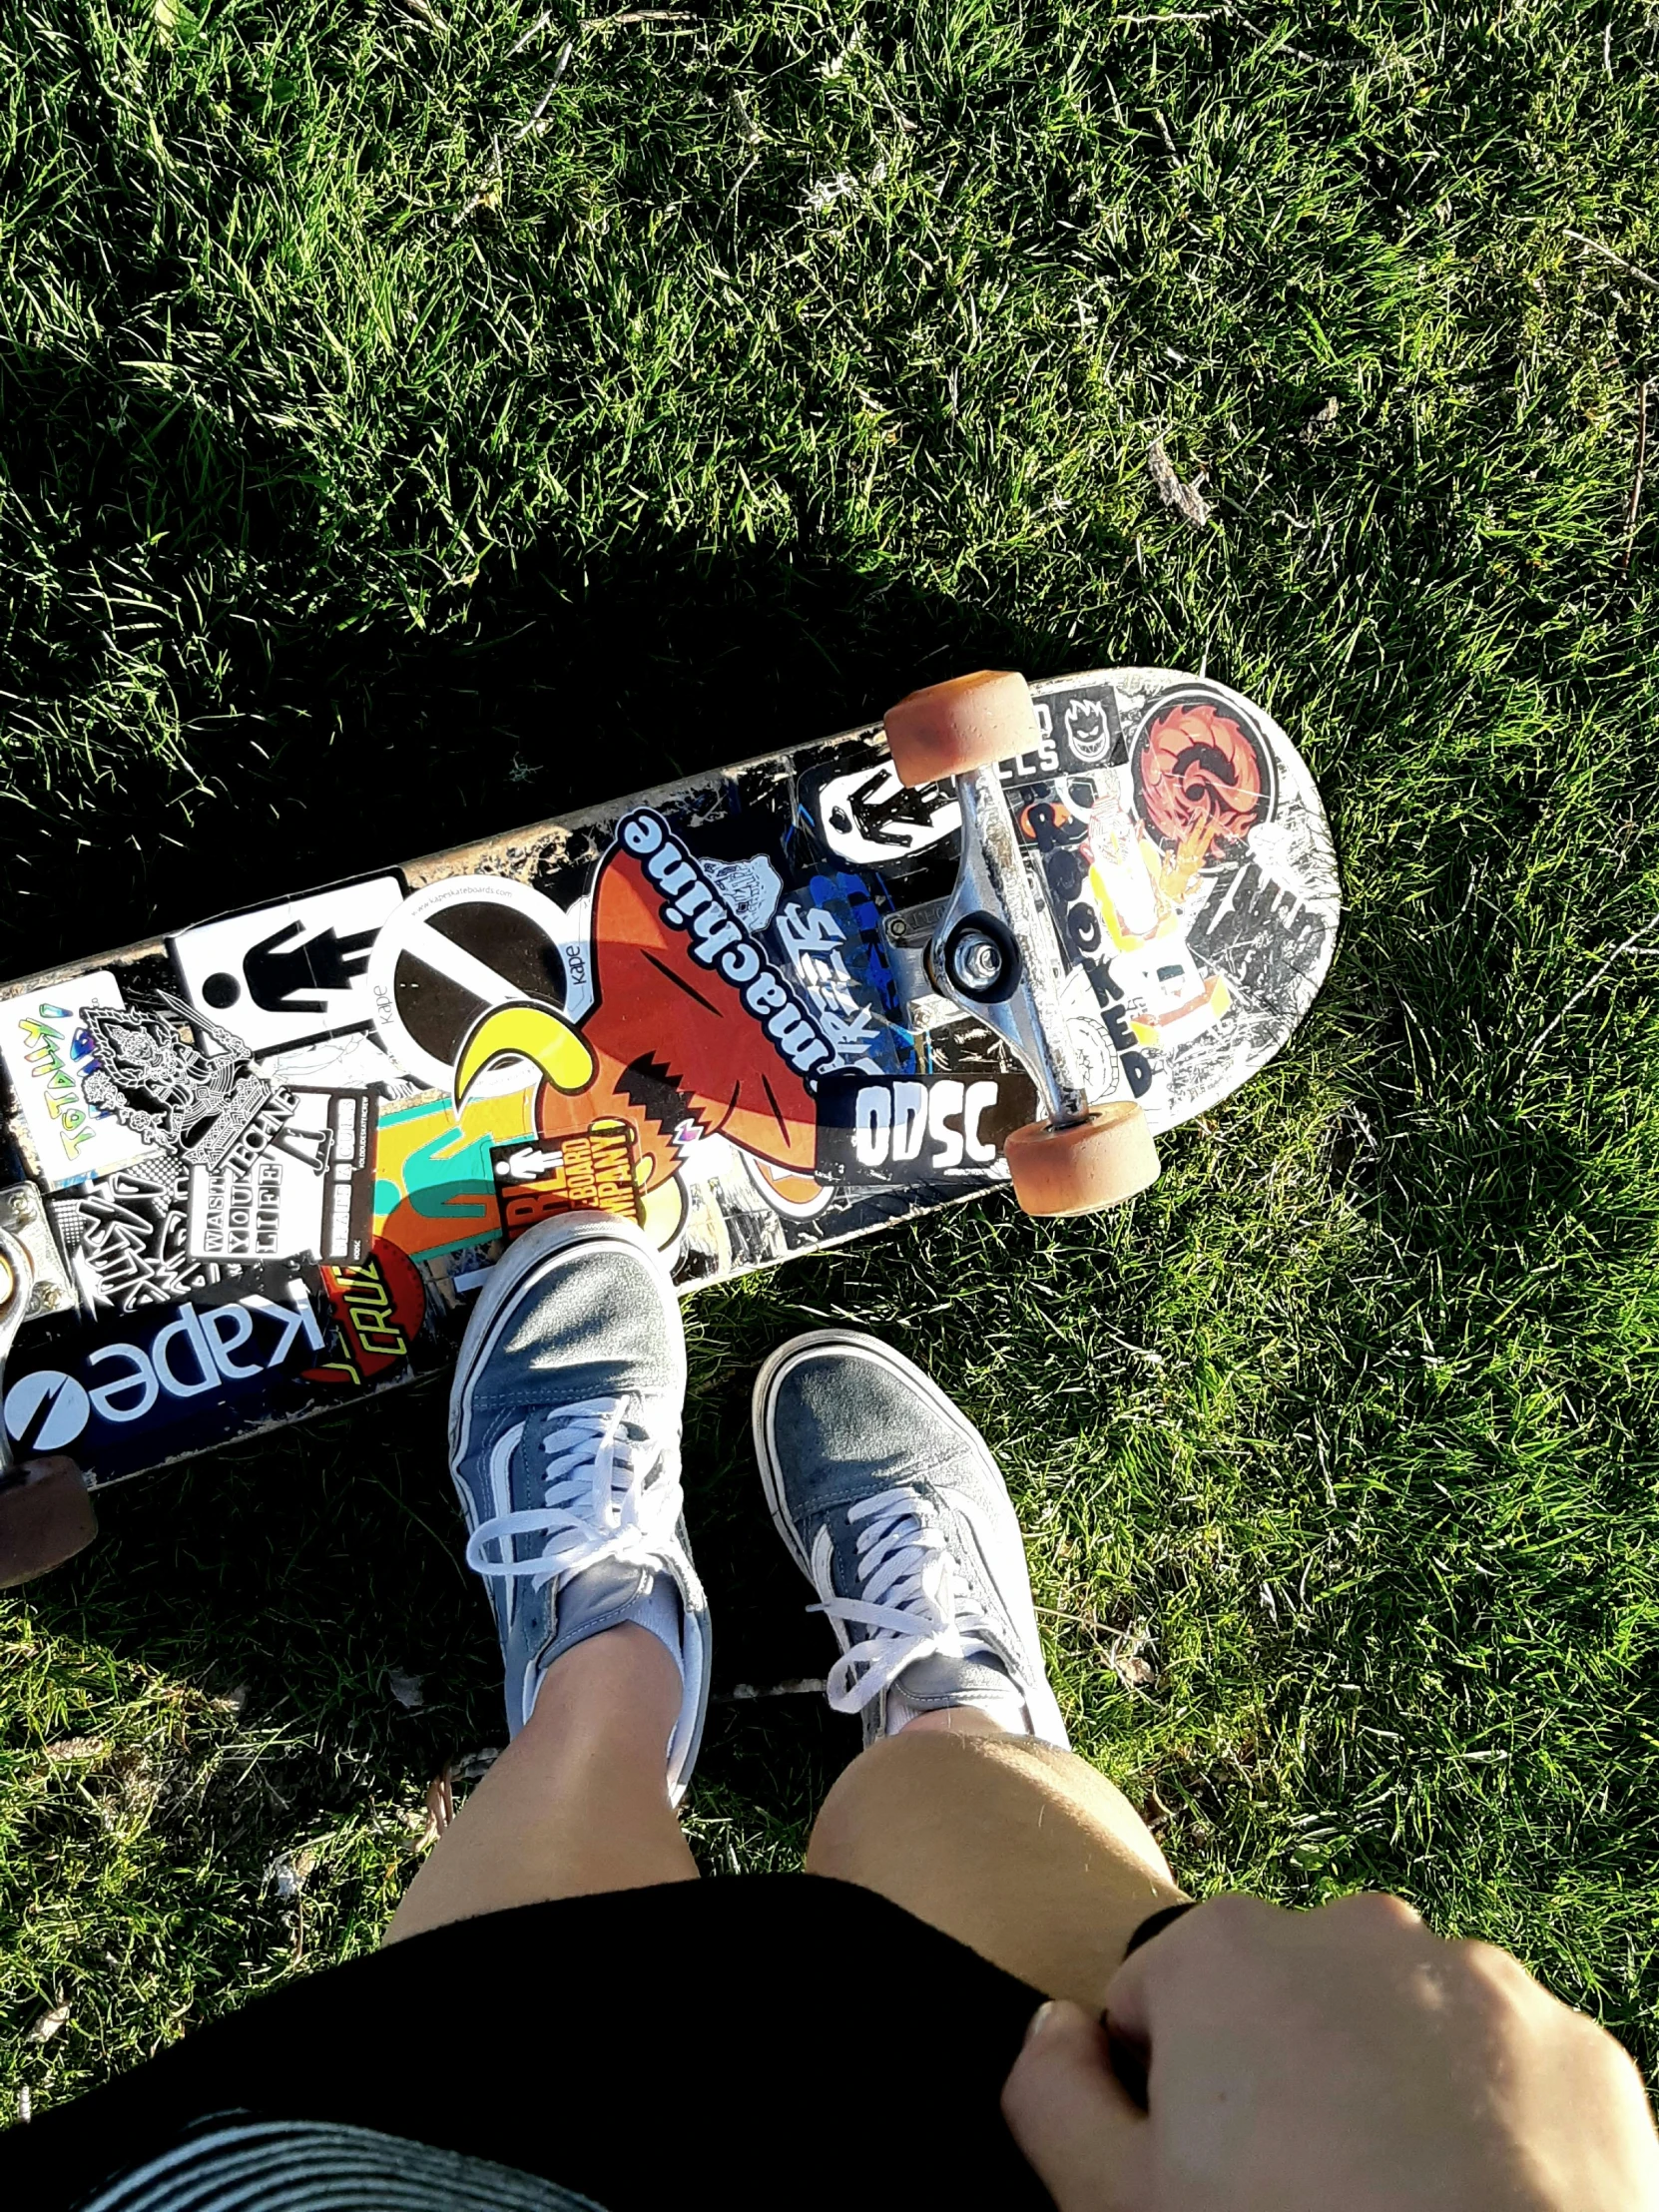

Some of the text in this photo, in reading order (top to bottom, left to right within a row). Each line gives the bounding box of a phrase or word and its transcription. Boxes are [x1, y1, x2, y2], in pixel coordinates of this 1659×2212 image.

[624, 814, 827, 1071] machine
[18, 1017, 96, 1161] TOTALLY
[223, 1089, 301, 1178] TECHNE
[855, 1079, 998, 1168] ODSC
[256, 1162, 283, 1253] LIFE
[335, 1163, 353, 1181] A
[504, 1164, 569, 1241] RL
[562, 1136, 600, 1210] EBOARD
[597, 1129, 638, 1222] MPANY
[329, 1184, 351, 1258] SKATE
[88, 1279, 325, 1422] kape
